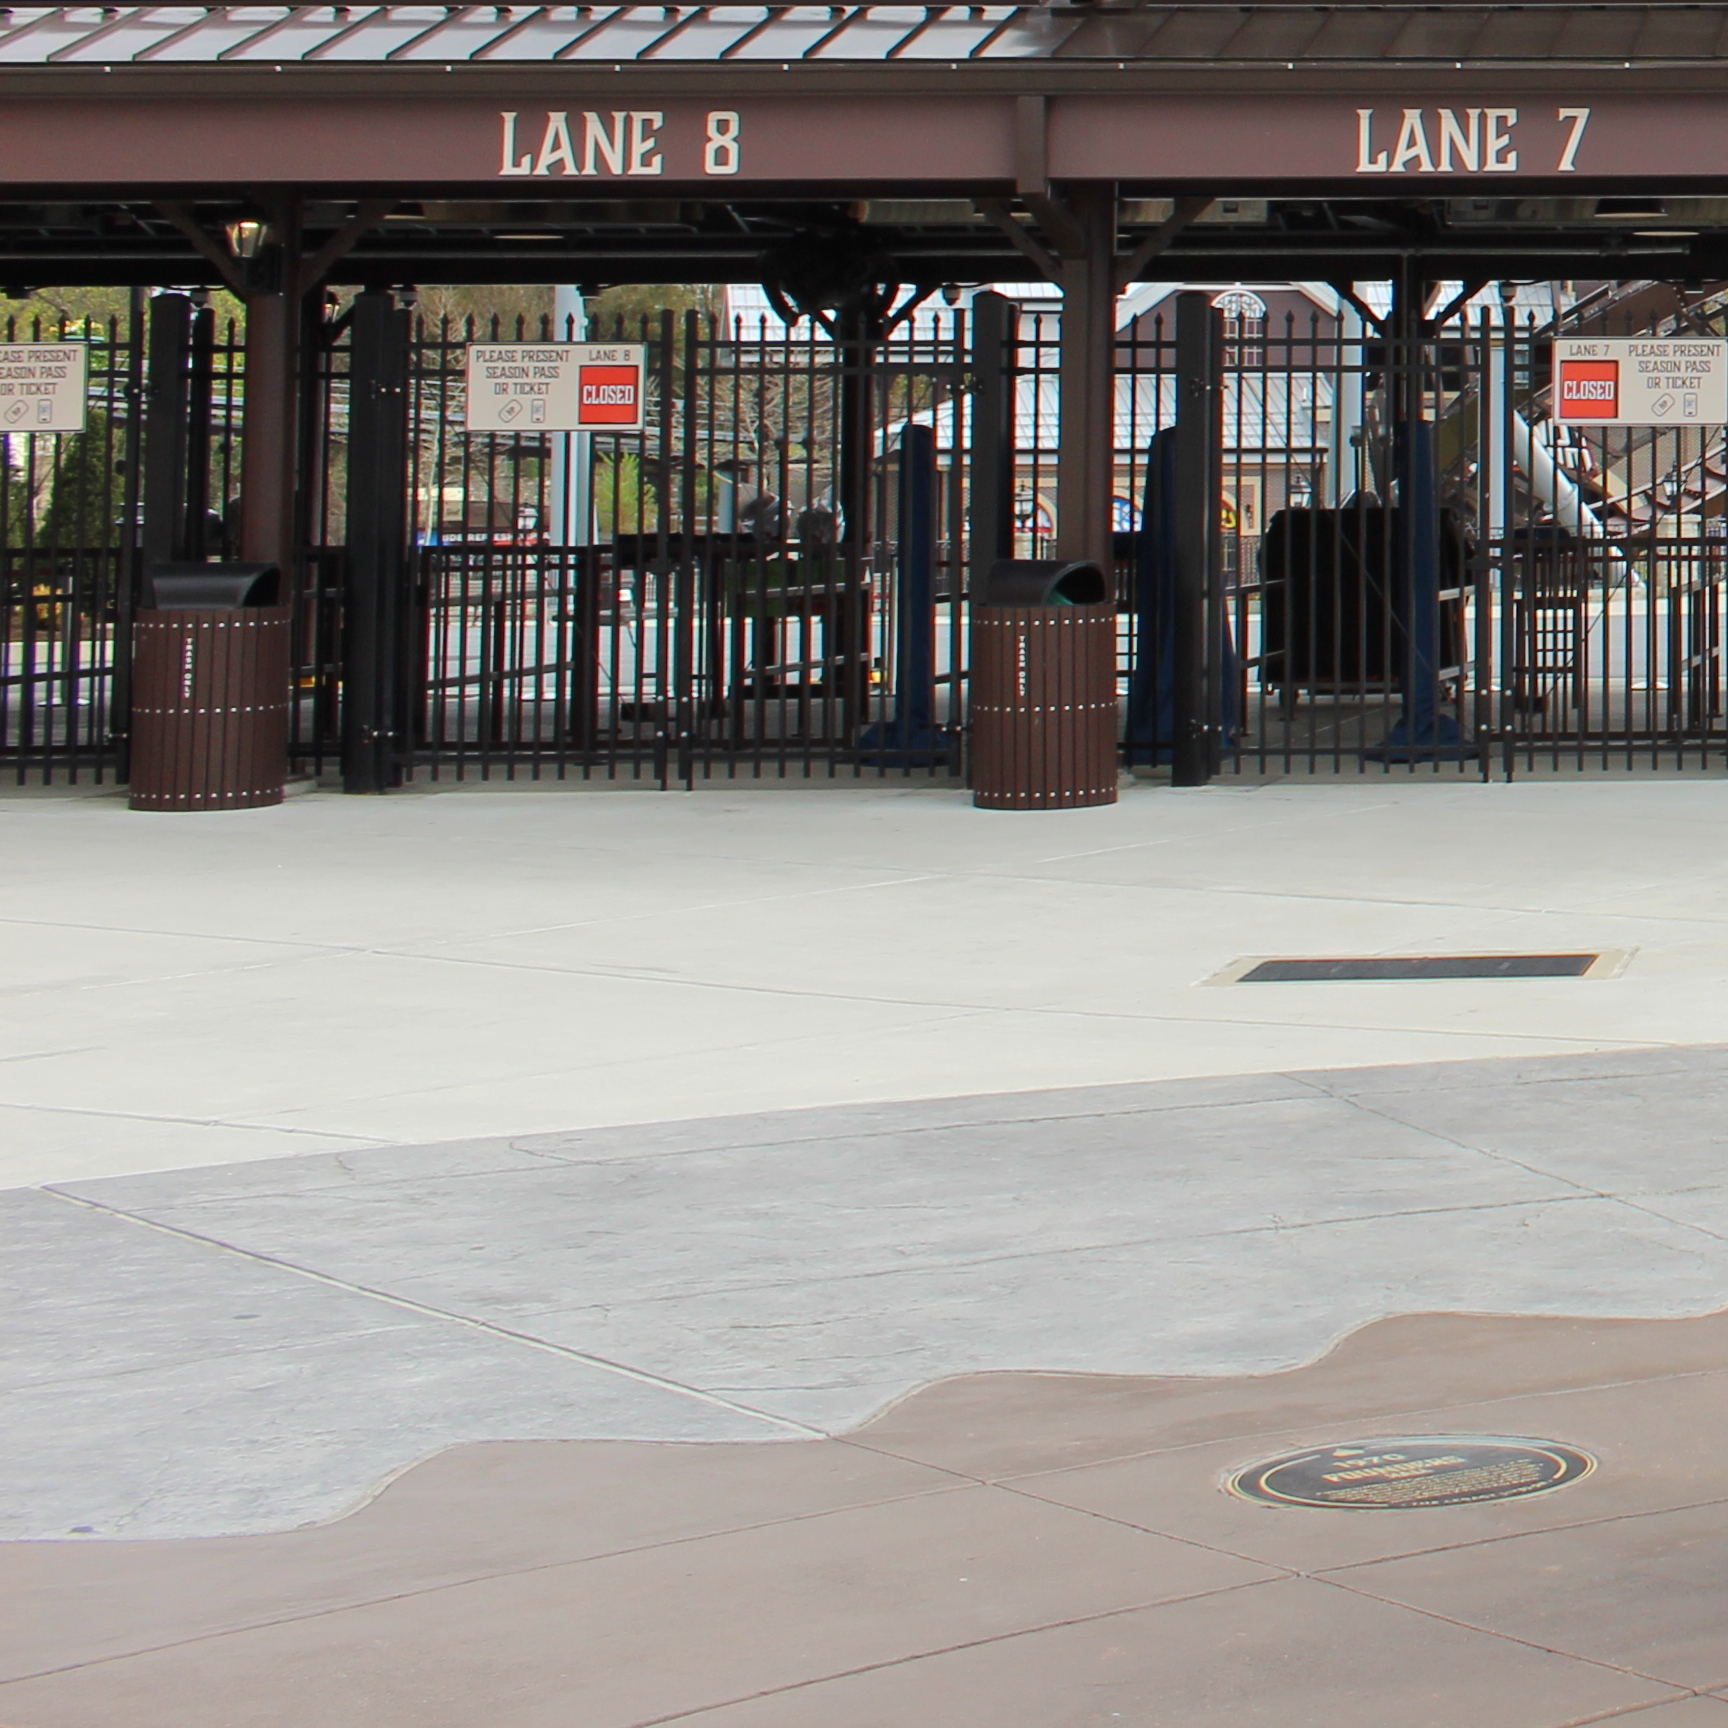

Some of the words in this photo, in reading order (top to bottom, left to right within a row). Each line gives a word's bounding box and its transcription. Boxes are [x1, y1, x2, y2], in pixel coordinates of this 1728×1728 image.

[498, 111, 664, 177] LANE
[705, 111, 741, 176] 8
[1356, 108, 1519, 172] LANE
[1557, 108, 1590, 172] 7
[28, 350, 78, 362] PRESENT
[476, 350, 518, 363] PLEASE
[521, 350, 571, 363] PRESENT
[589, 350, 617, 361] LANE
[623, 350, 631, 361] 8
[1569, 345, 1598, 356] LANE
[1603, 345, 1610, 356] 7
[1628, 344, 1670, 357] PLEASE
[1673, 344, 1722, 357] PRESENT
[40, 366, 67, 378] PASS
[486, 366, 529, 379] SEASON
[533, 366, 560, 379] PASS
[1638, 361, 1681, 373] SEASON
[1685, 361, 1711, 373] PASS
[18, 383, 57, 395] TICKET
[494, 382, 509, 395] OR
[513, 382, 551, 395] TICKET
[1646, 377, 1661, 389] OR
[1665, 377, 1702, 389] TICKET
[583, 385, 635, 405] CLOSED
[1563, 380, 1615, 400] CLOSED
